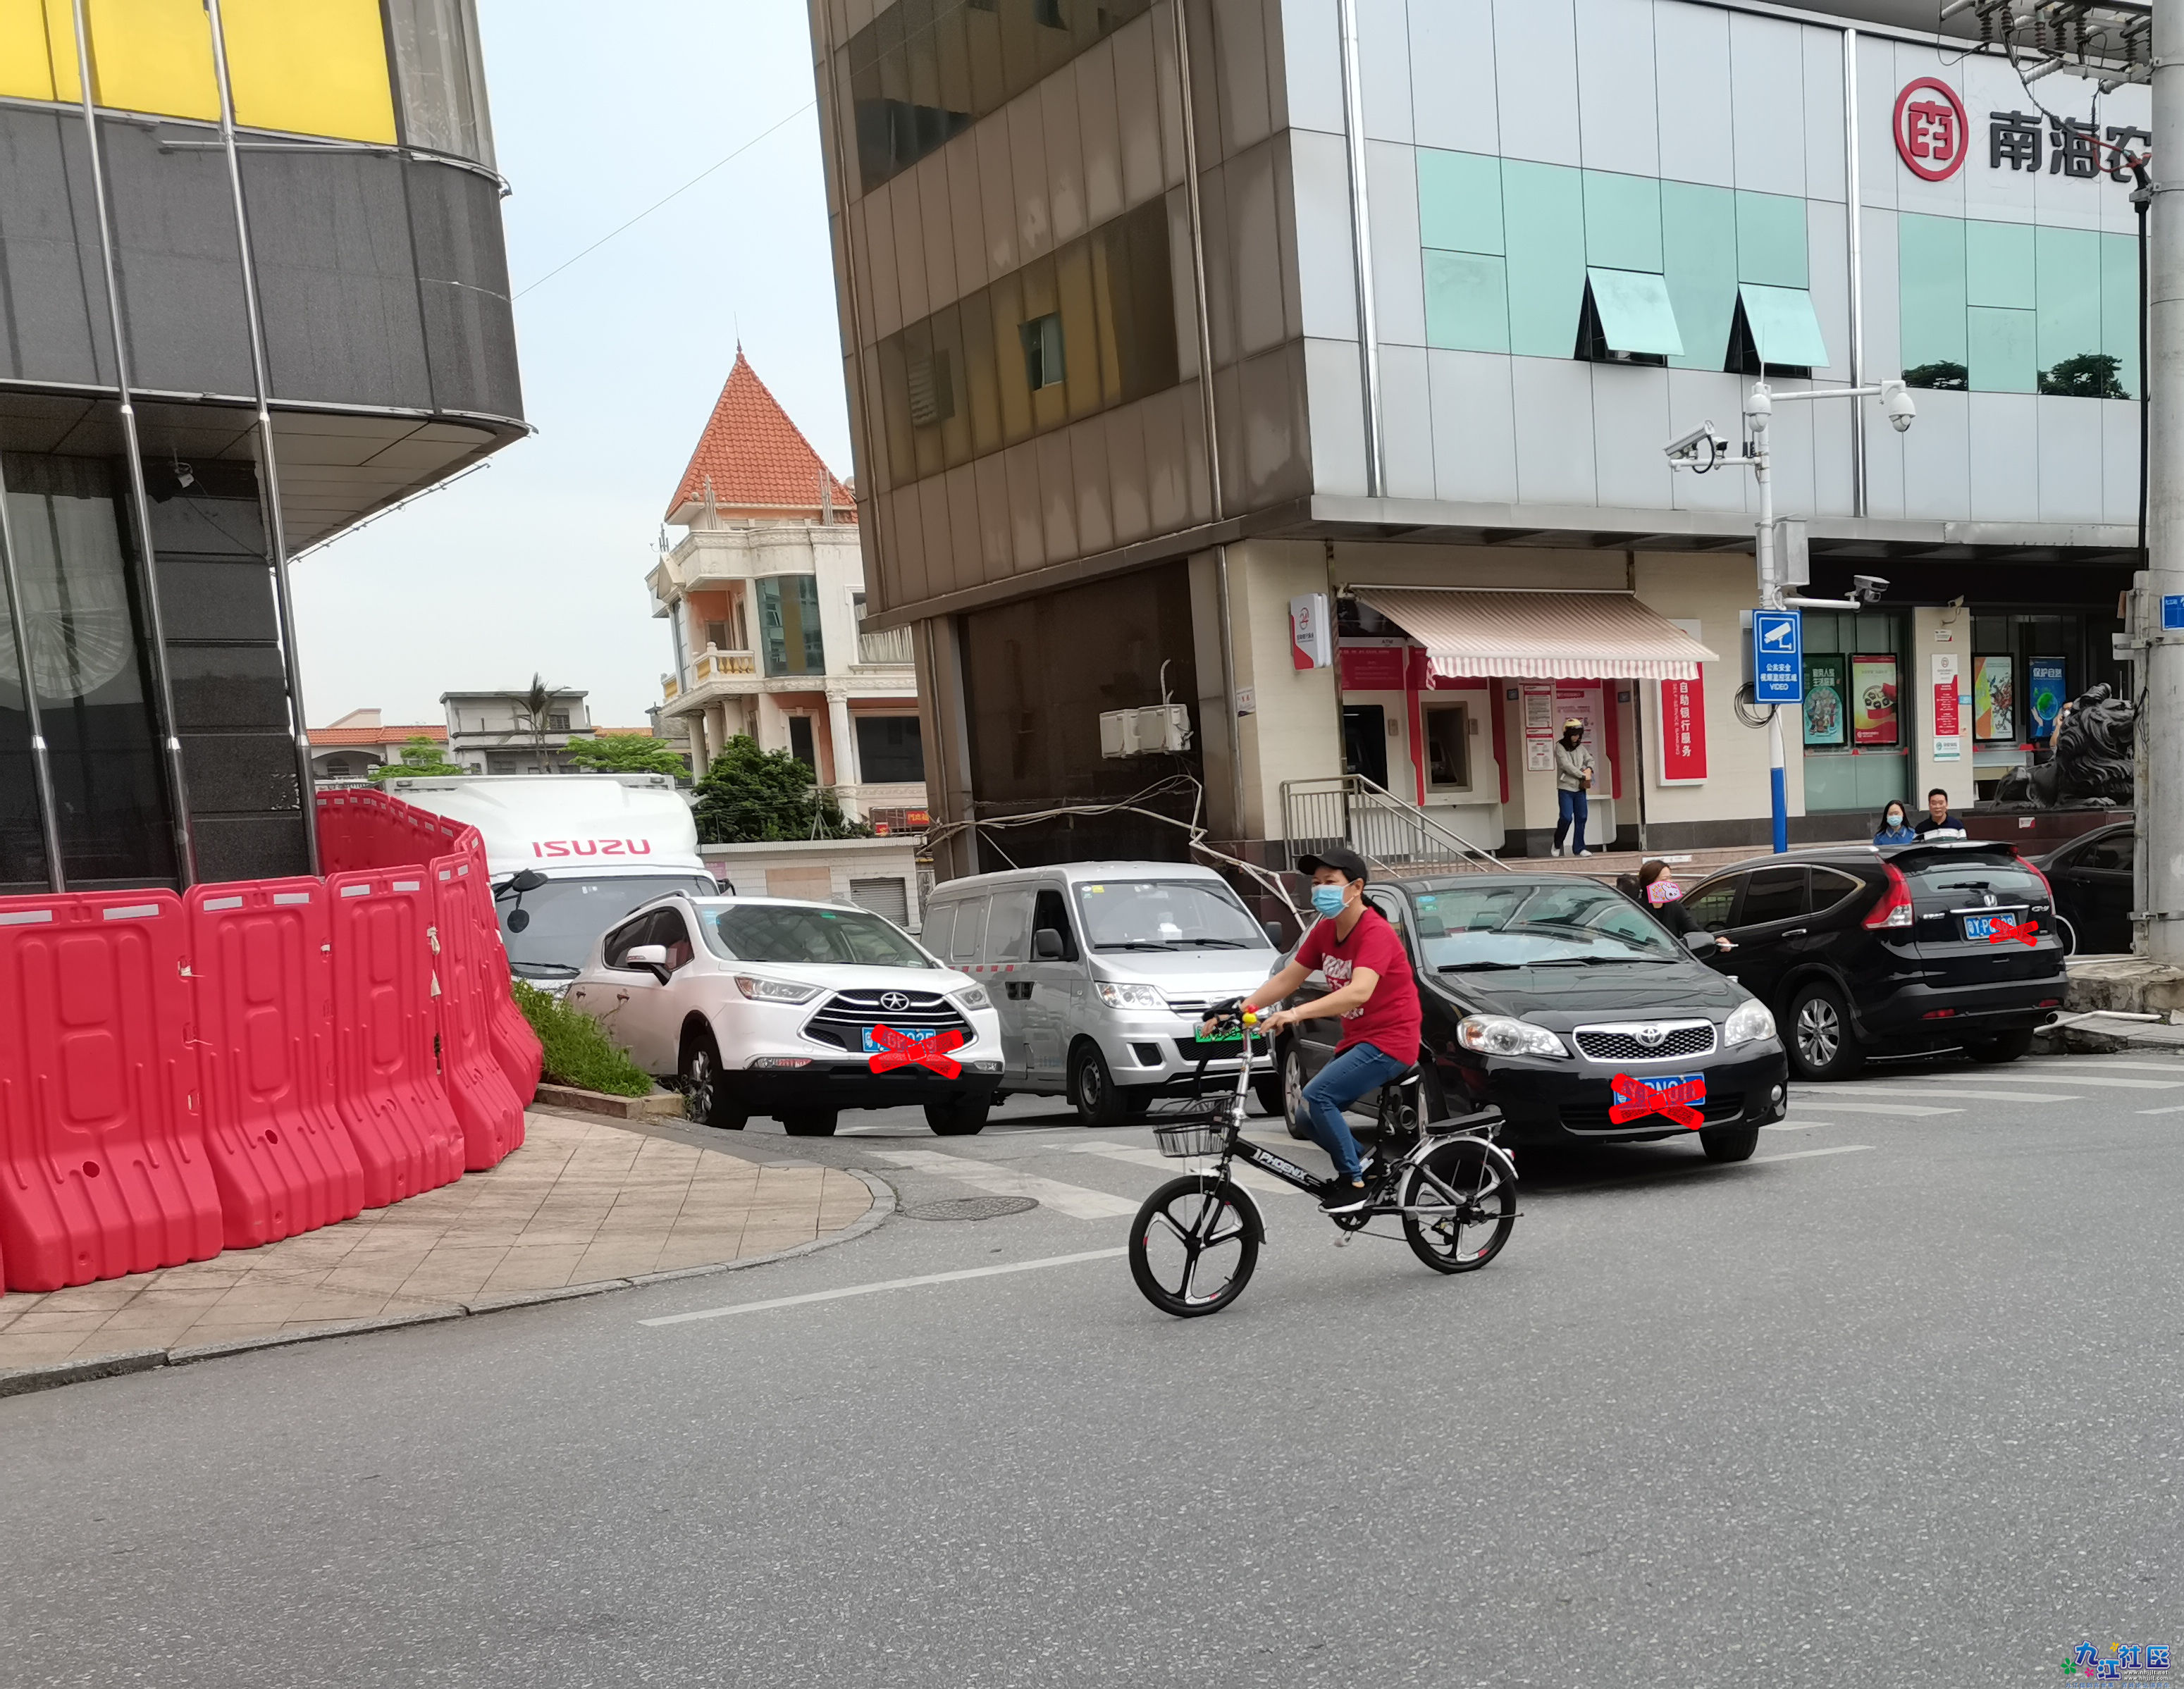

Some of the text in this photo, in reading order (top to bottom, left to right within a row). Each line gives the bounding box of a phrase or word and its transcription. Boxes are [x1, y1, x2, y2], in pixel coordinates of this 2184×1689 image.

[1766, 663, 1791, 672] 公共安全
[1679, 682, 1691, 757] 自助银行服务
[531, 839, 651, 858] ISUZU
[1259, 1151, 1309, 1181] PHOENIX
